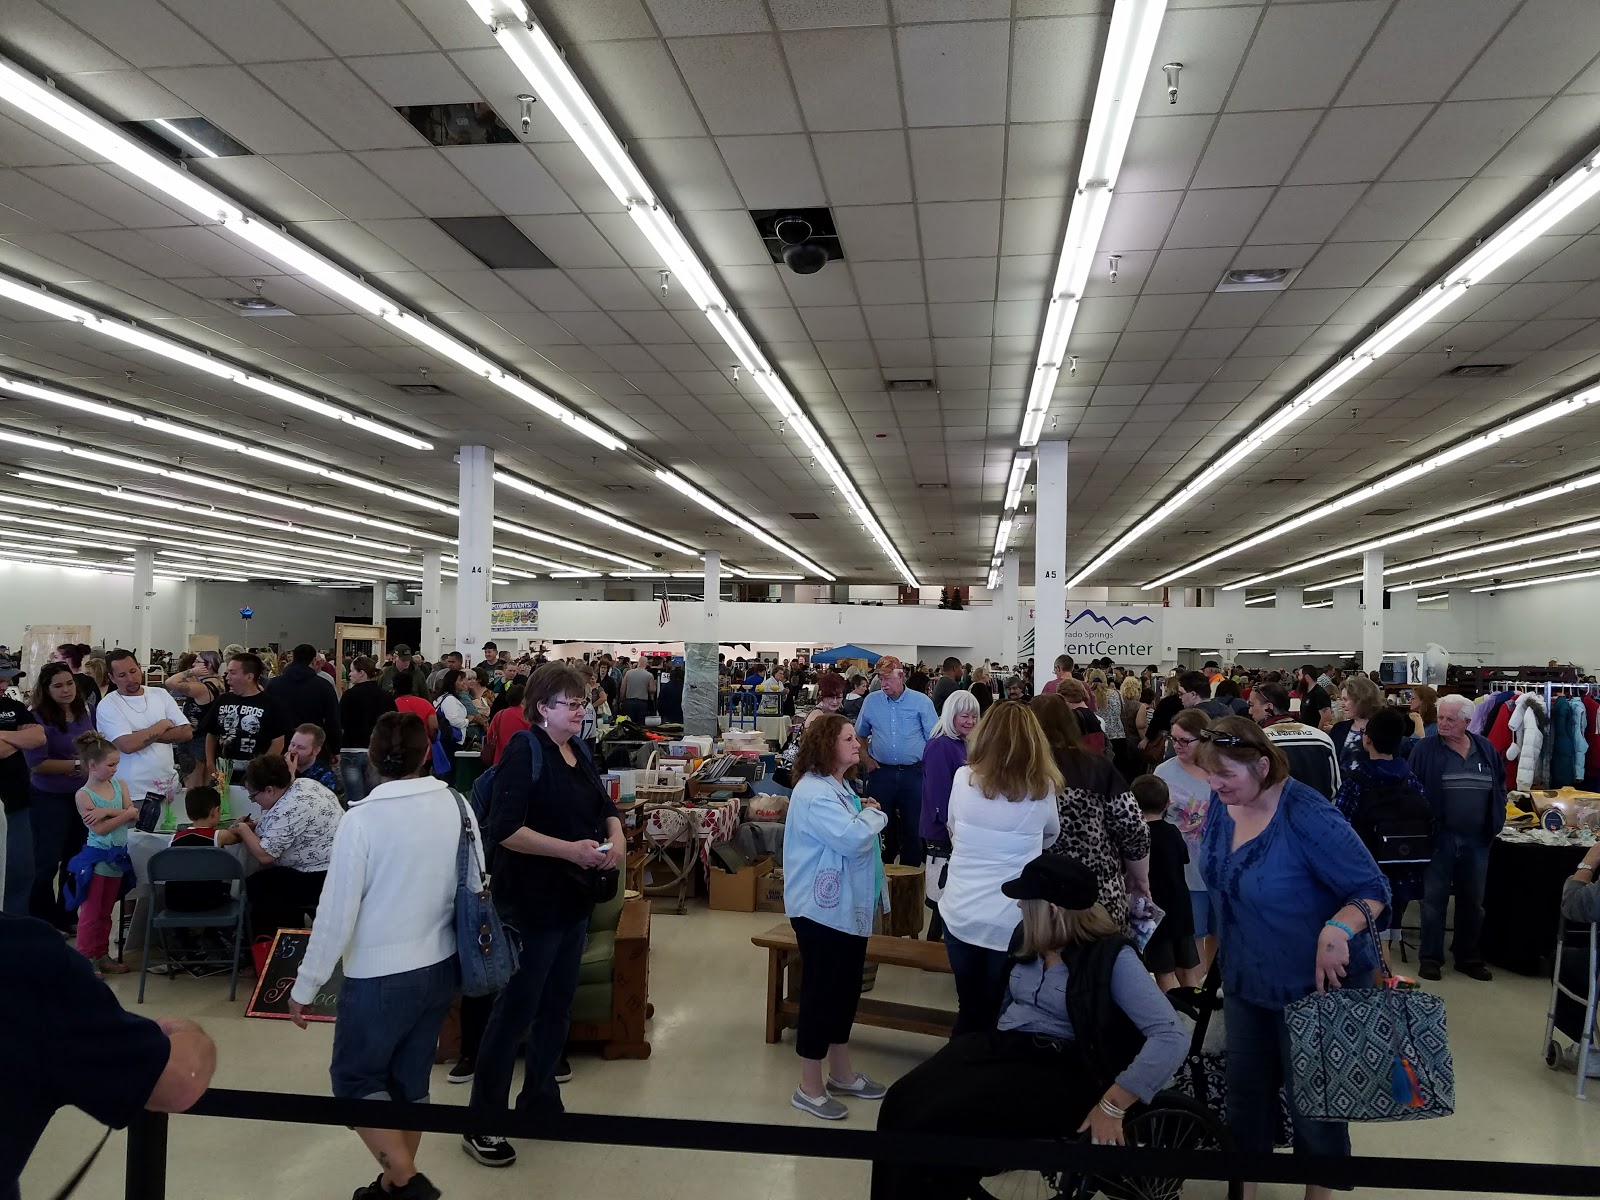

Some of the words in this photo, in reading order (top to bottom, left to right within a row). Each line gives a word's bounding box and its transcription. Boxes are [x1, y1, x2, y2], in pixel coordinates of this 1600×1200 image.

[471, 566, 482, 574] A4
[1045, 570, 1057, 579] A5
[1084, 630, 1114, 640] Springs
[218, 704, 240, 715] SACK
[240, 705, 265, 718] BROS
